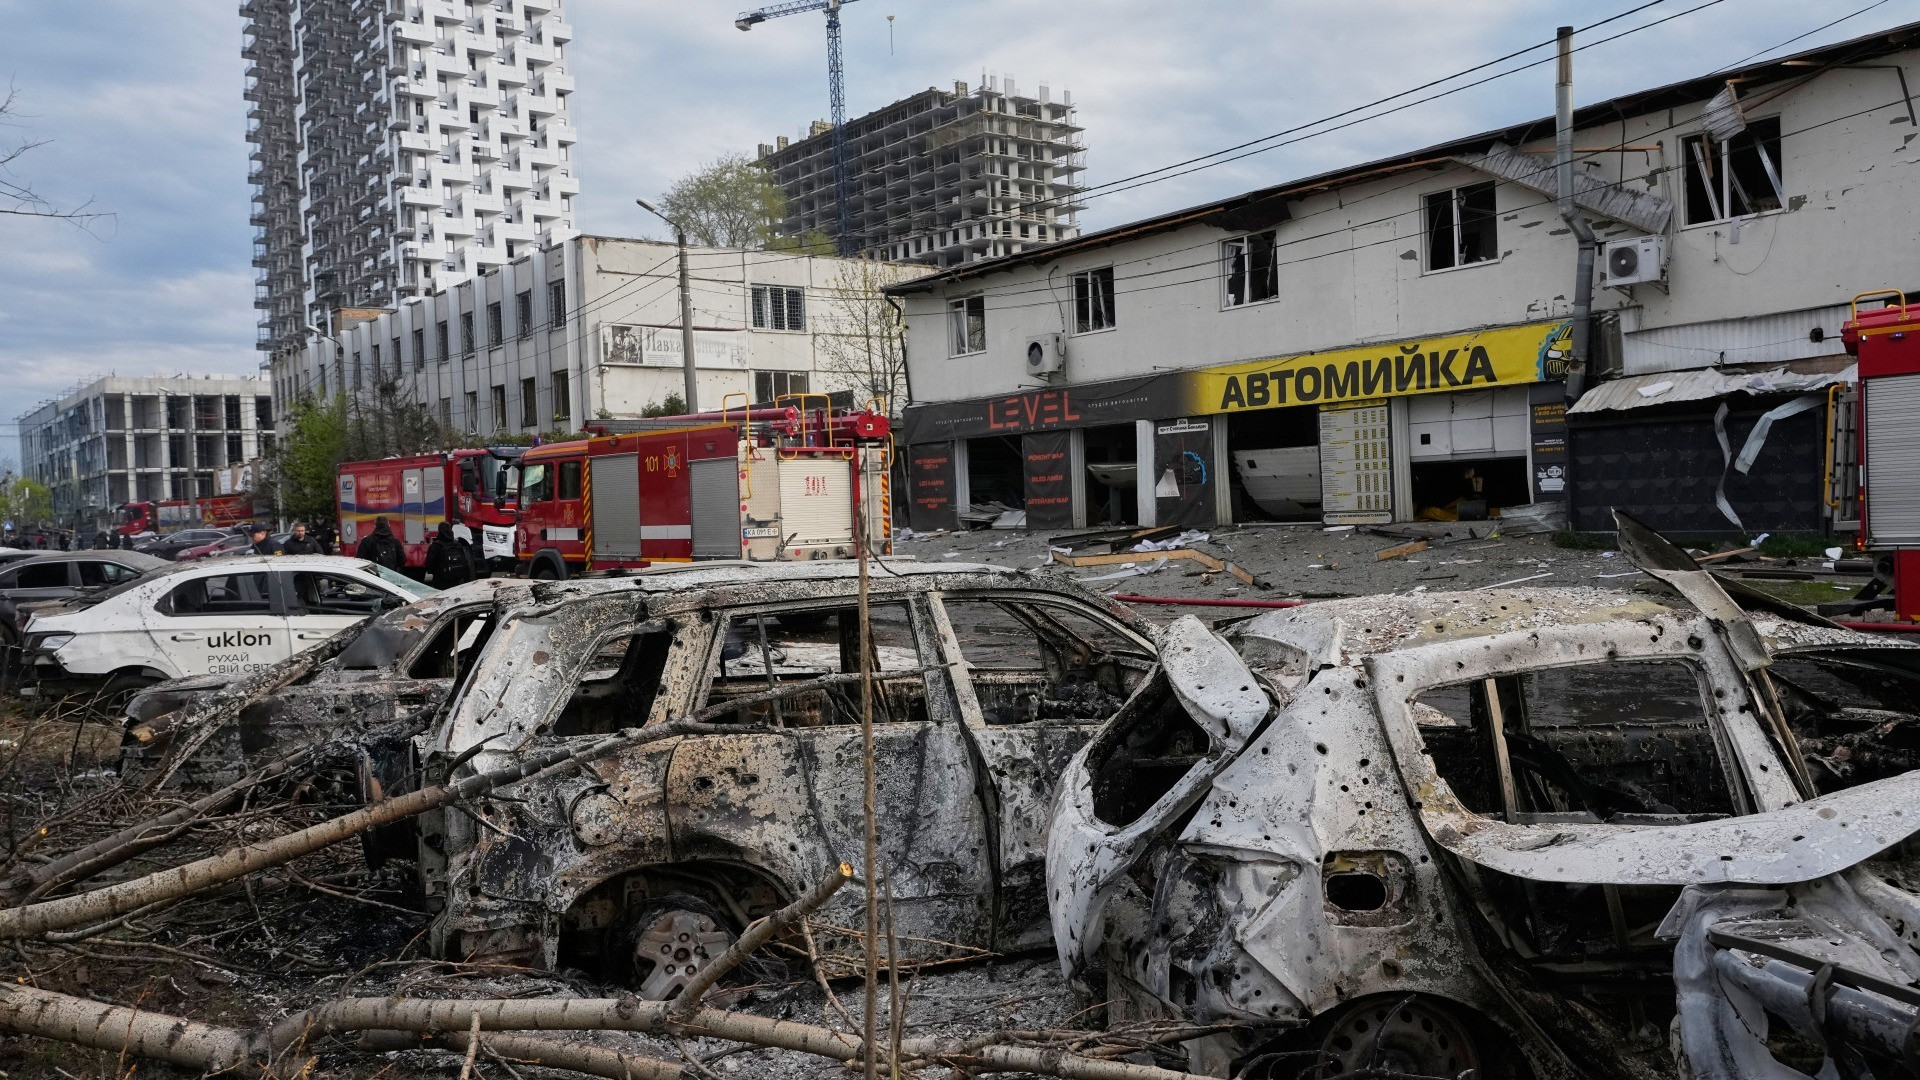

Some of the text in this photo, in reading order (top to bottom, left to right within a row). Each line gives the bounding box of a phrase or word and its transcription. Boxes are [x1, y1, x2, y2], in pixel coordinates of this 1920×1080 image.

[1220, 344, 1498, 409] АВТОМИЙКА
[989, 391, 1080, 429] LEVEL
[645, 456, 659, 472] 101
[805, 476, 829, 496] 101
[207, 631, 271, 648] uklon
[207, 651, 249, 663] РУХАЙ
[208, 663, 239, 674] СВІЙ
